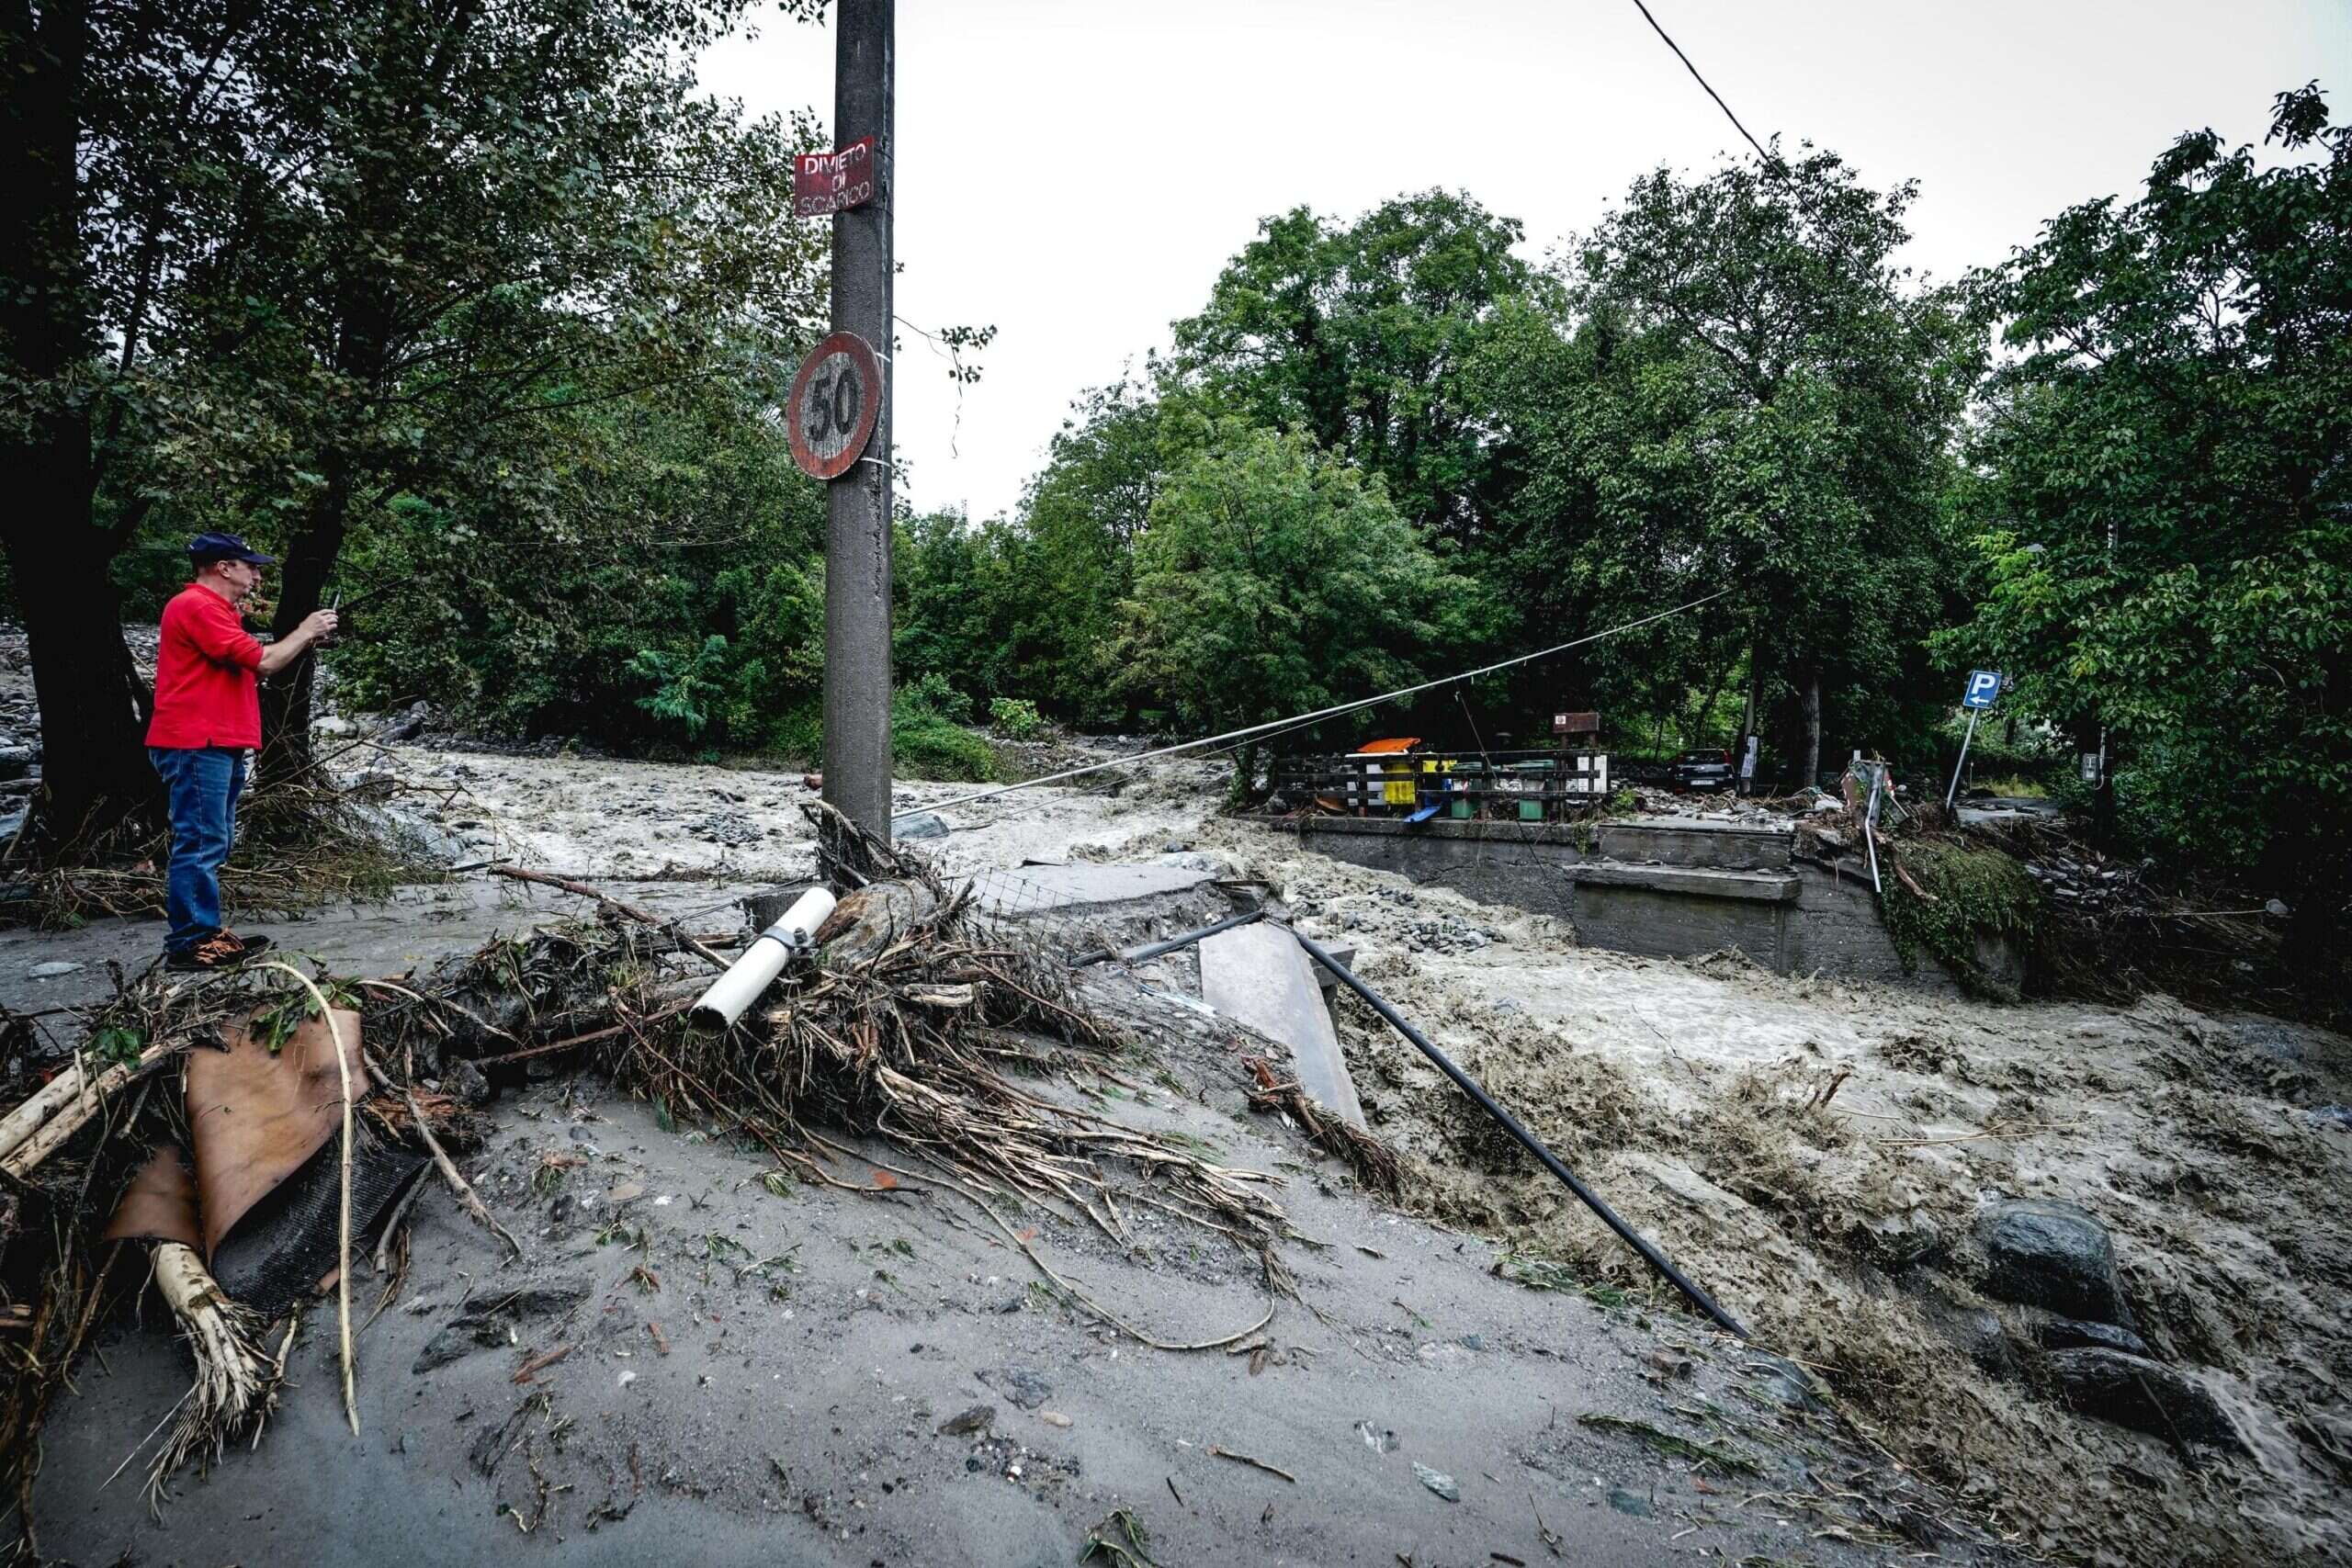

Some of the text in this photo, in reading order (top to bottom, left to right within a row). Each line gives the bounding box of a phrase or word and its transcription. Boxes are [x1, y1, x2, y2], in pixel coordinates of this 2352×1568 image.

[805, 143, 866, 175] DIVIETO
[831, 172, 846, 192] DI
[808, 368, 859, 441] 50
[1972, 673, 1996, 694] P
